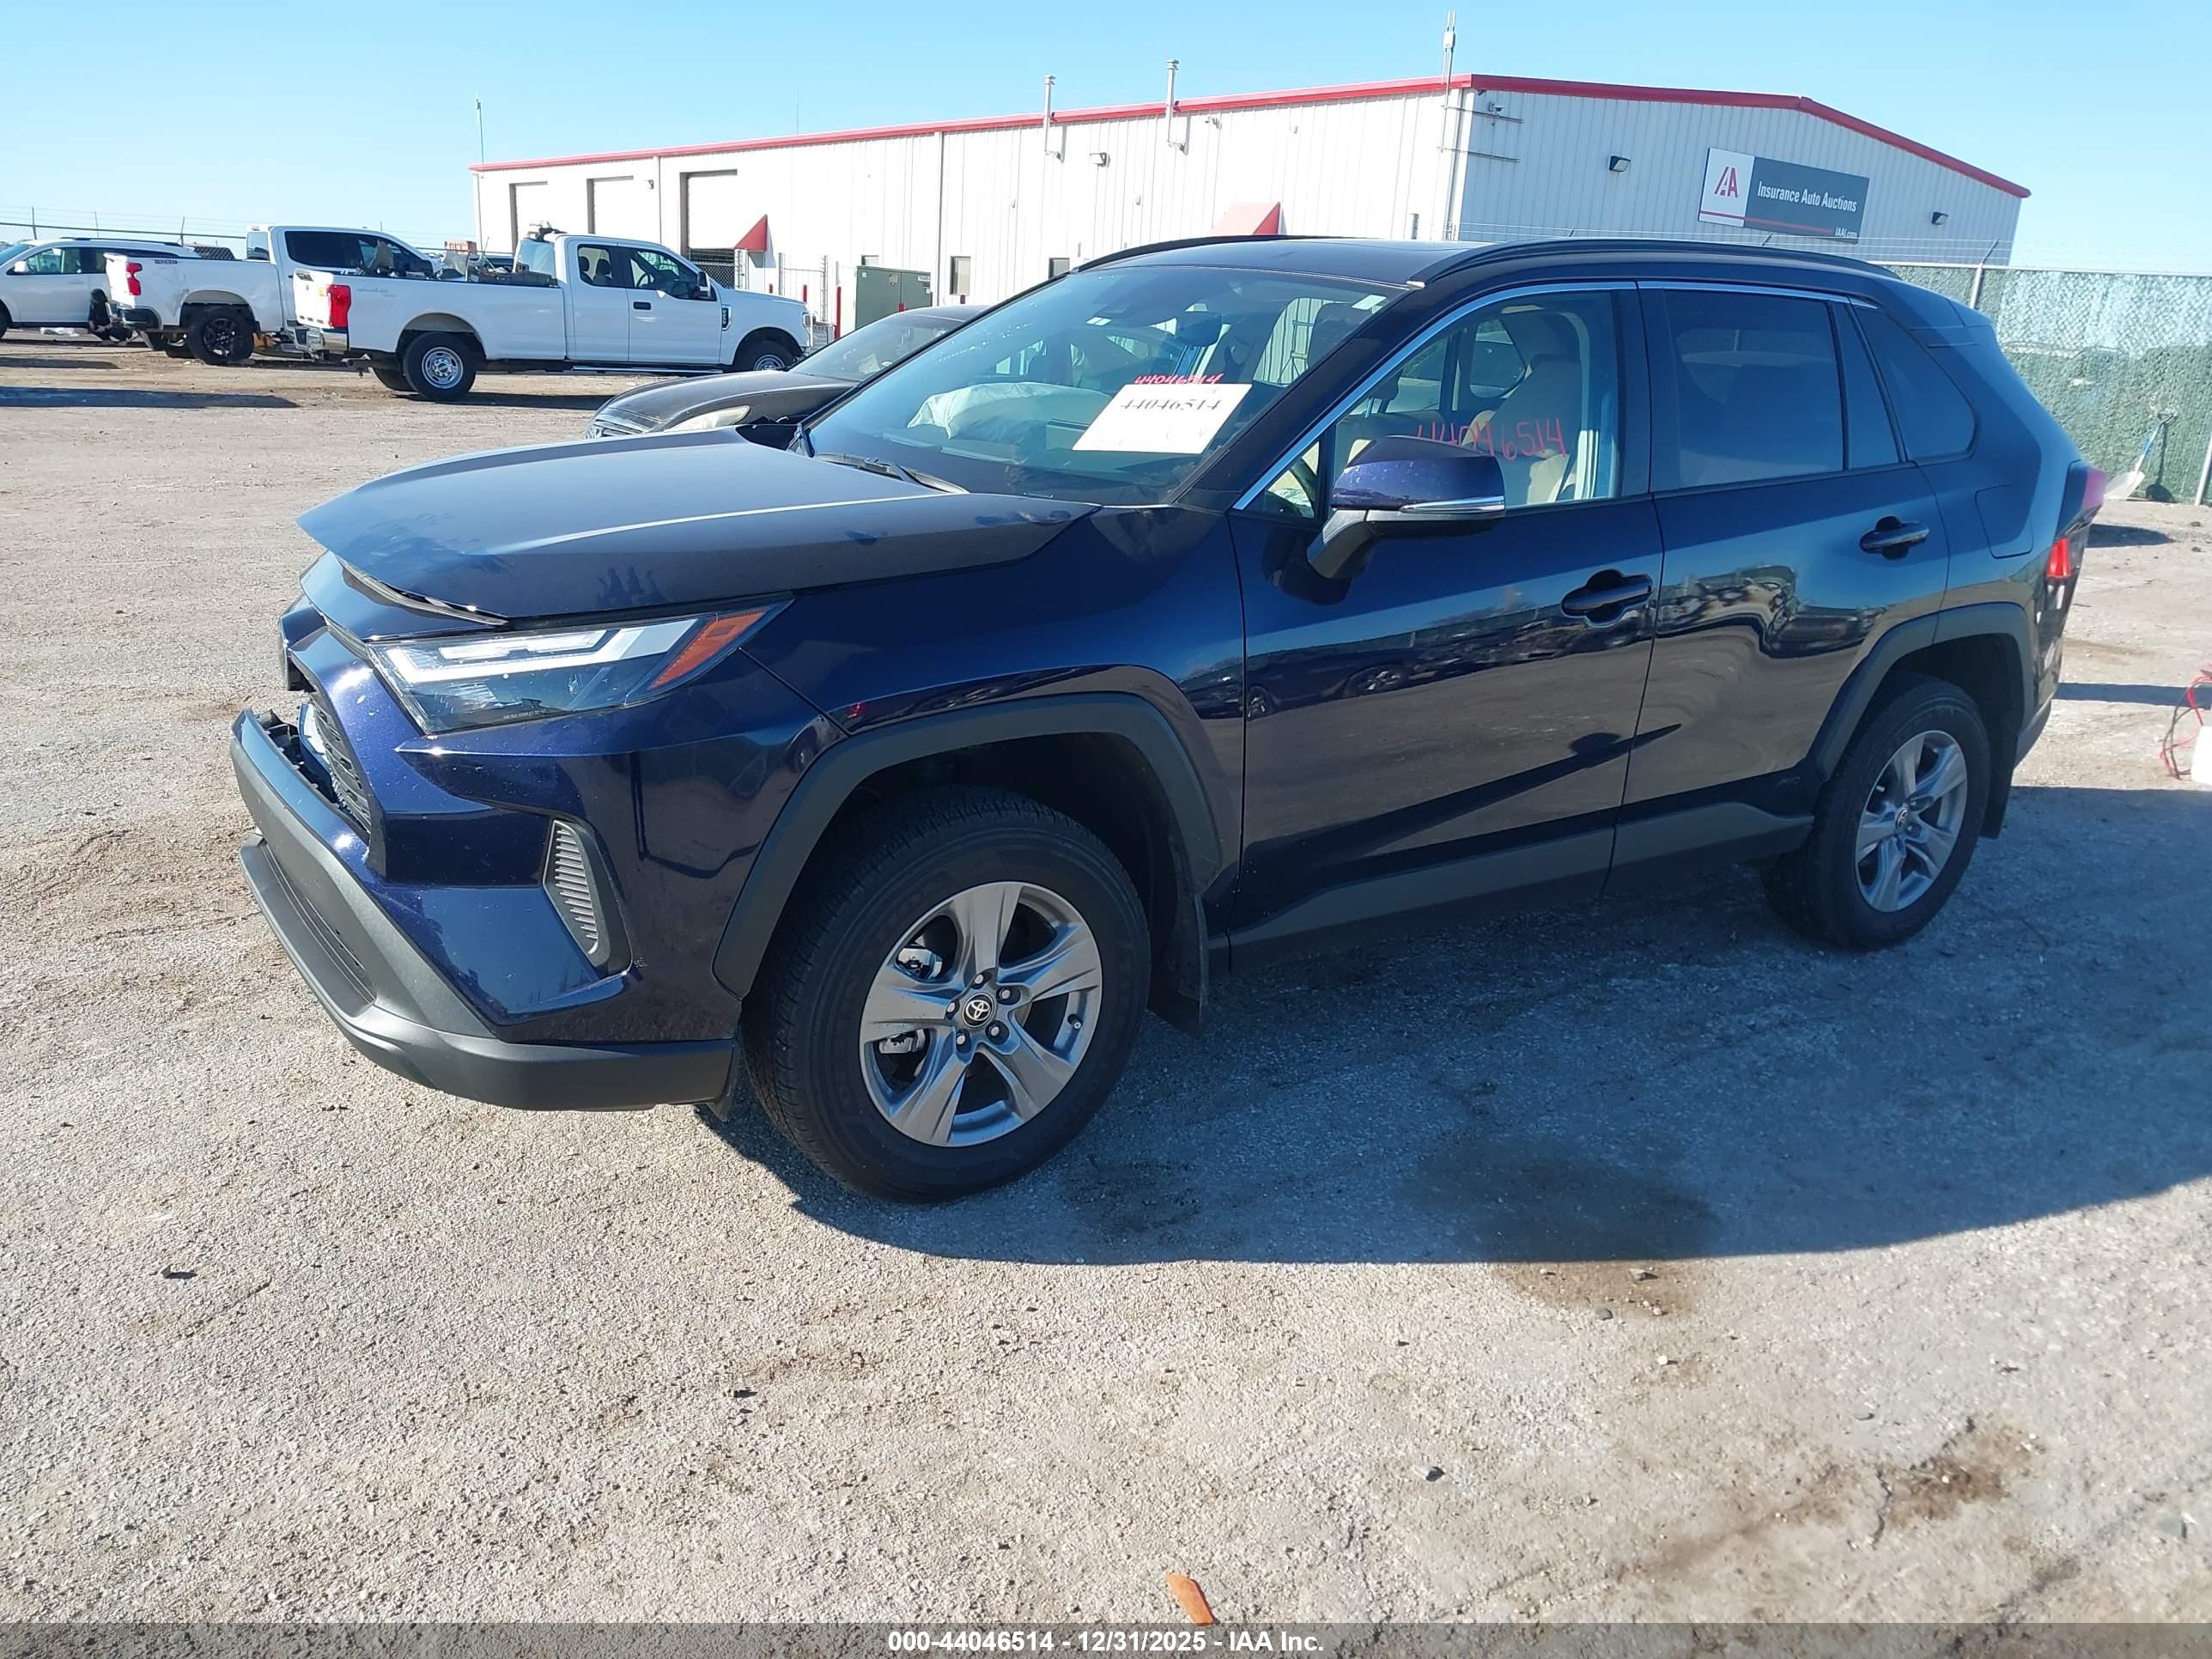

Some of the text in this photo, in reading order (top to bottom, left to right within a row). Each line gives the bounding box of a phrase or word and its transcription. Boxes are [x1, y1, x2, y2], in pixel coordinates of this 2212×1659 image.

[1757, 180, 1857, 213] Insurance Auto Auctions
[1121, 398, 1223, 410] 44046514
